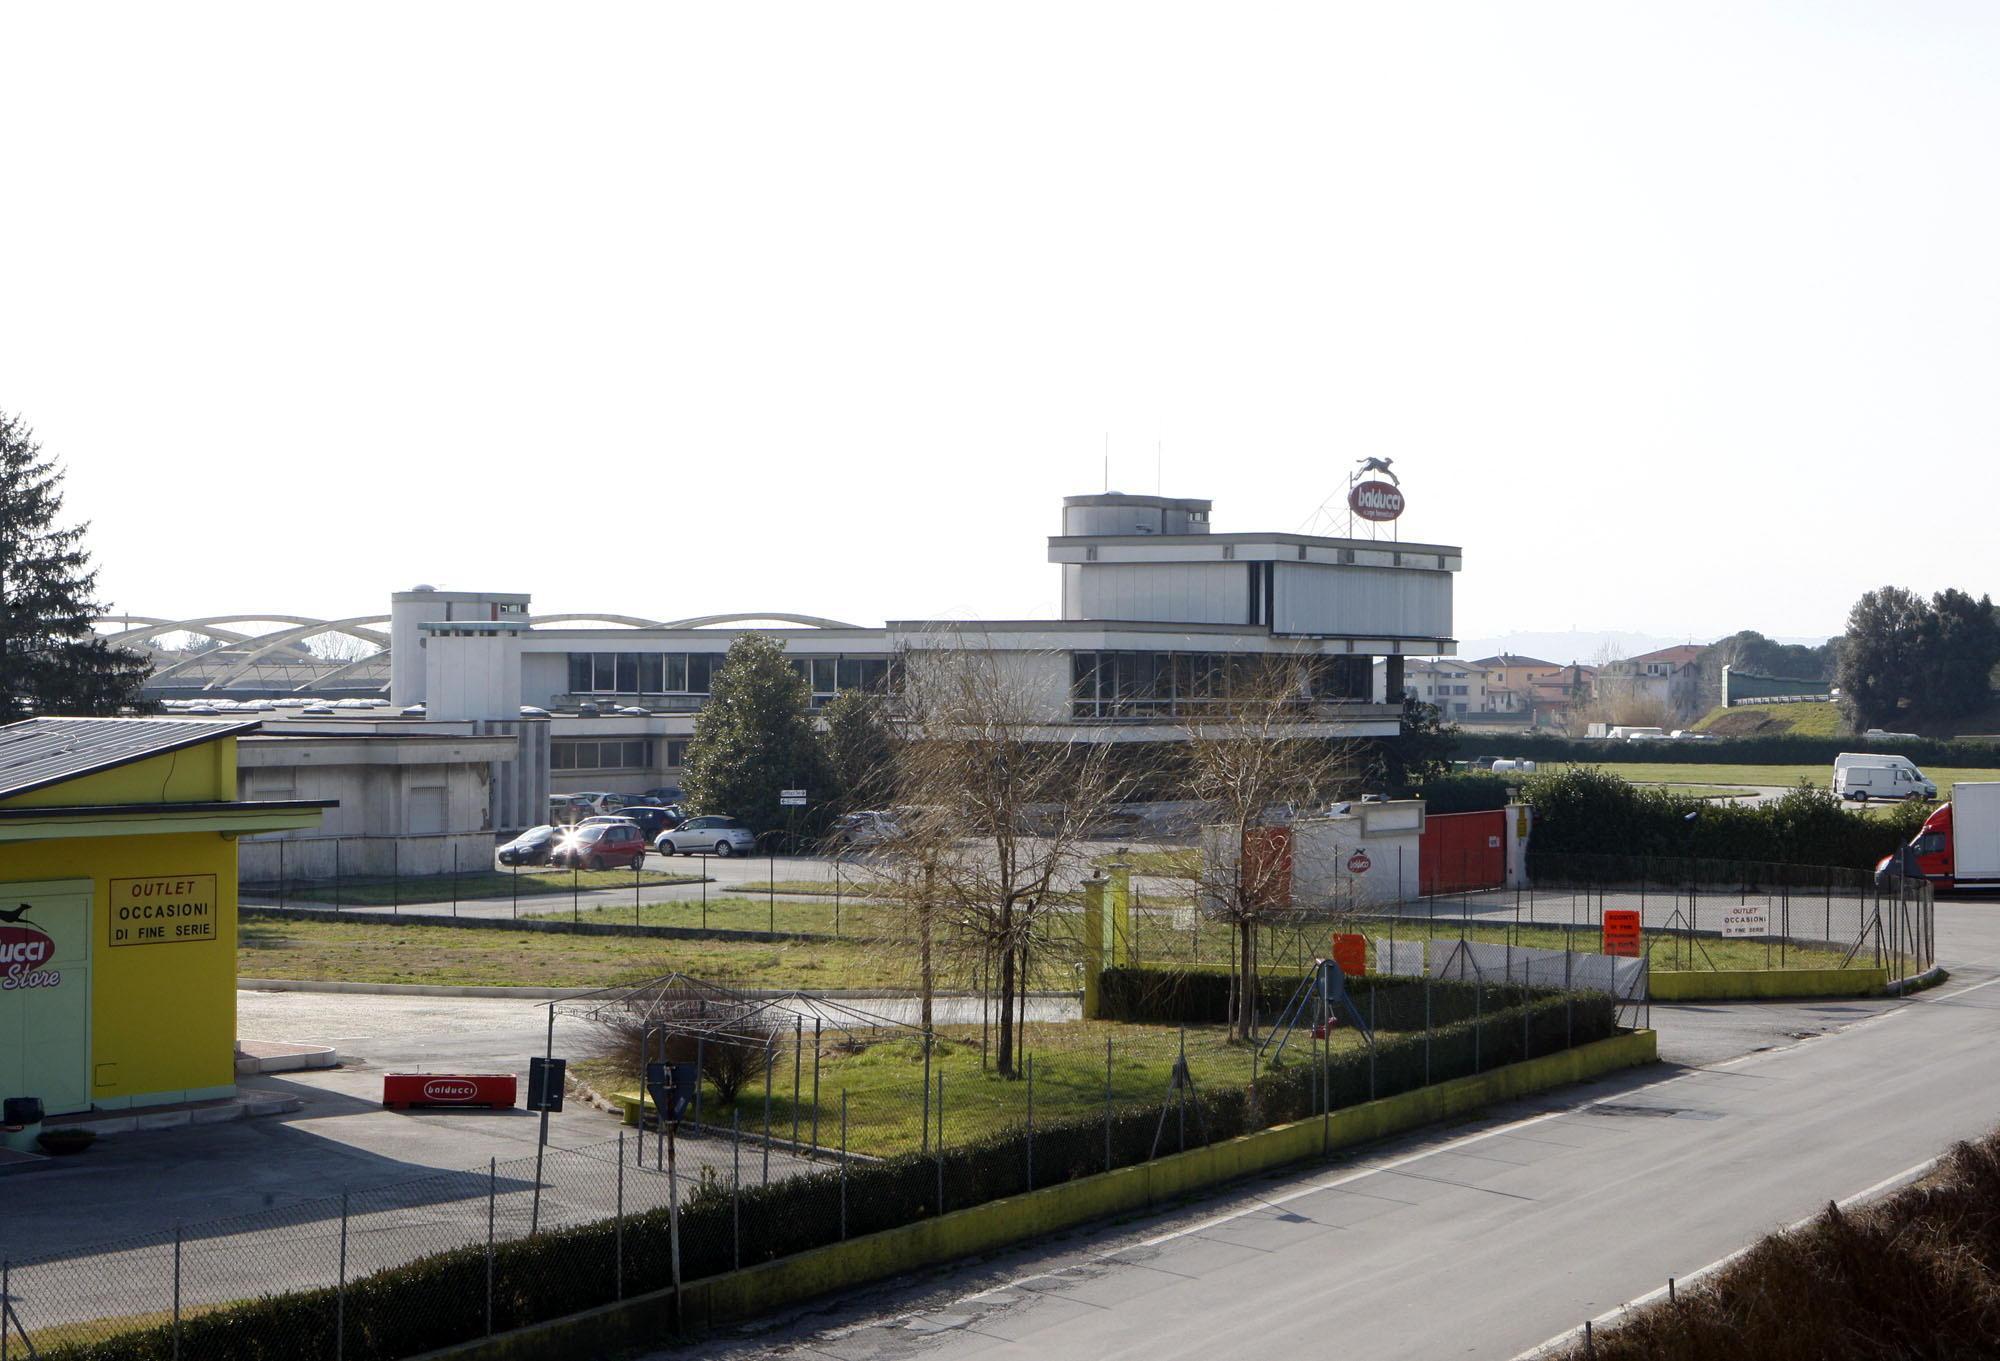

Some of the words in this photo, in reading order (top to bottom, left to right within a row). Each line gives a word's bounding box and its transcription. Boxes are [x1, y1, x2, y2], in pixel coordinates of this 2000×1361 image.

[1358, 487, 1400, 510] balducci
[131, 881, 195, 897] OUTLET
[120, 903, 208, 920] OCCASIONI
[116, 929, 128, 940] DI
[138, 926, 165, 938] FINE
[175, 923, 210, 936] SERIE
[0, 939, 45, 962] ucci
[3, 962, 60, 989] Store
[428, 1086, 473, 1094] balducci
